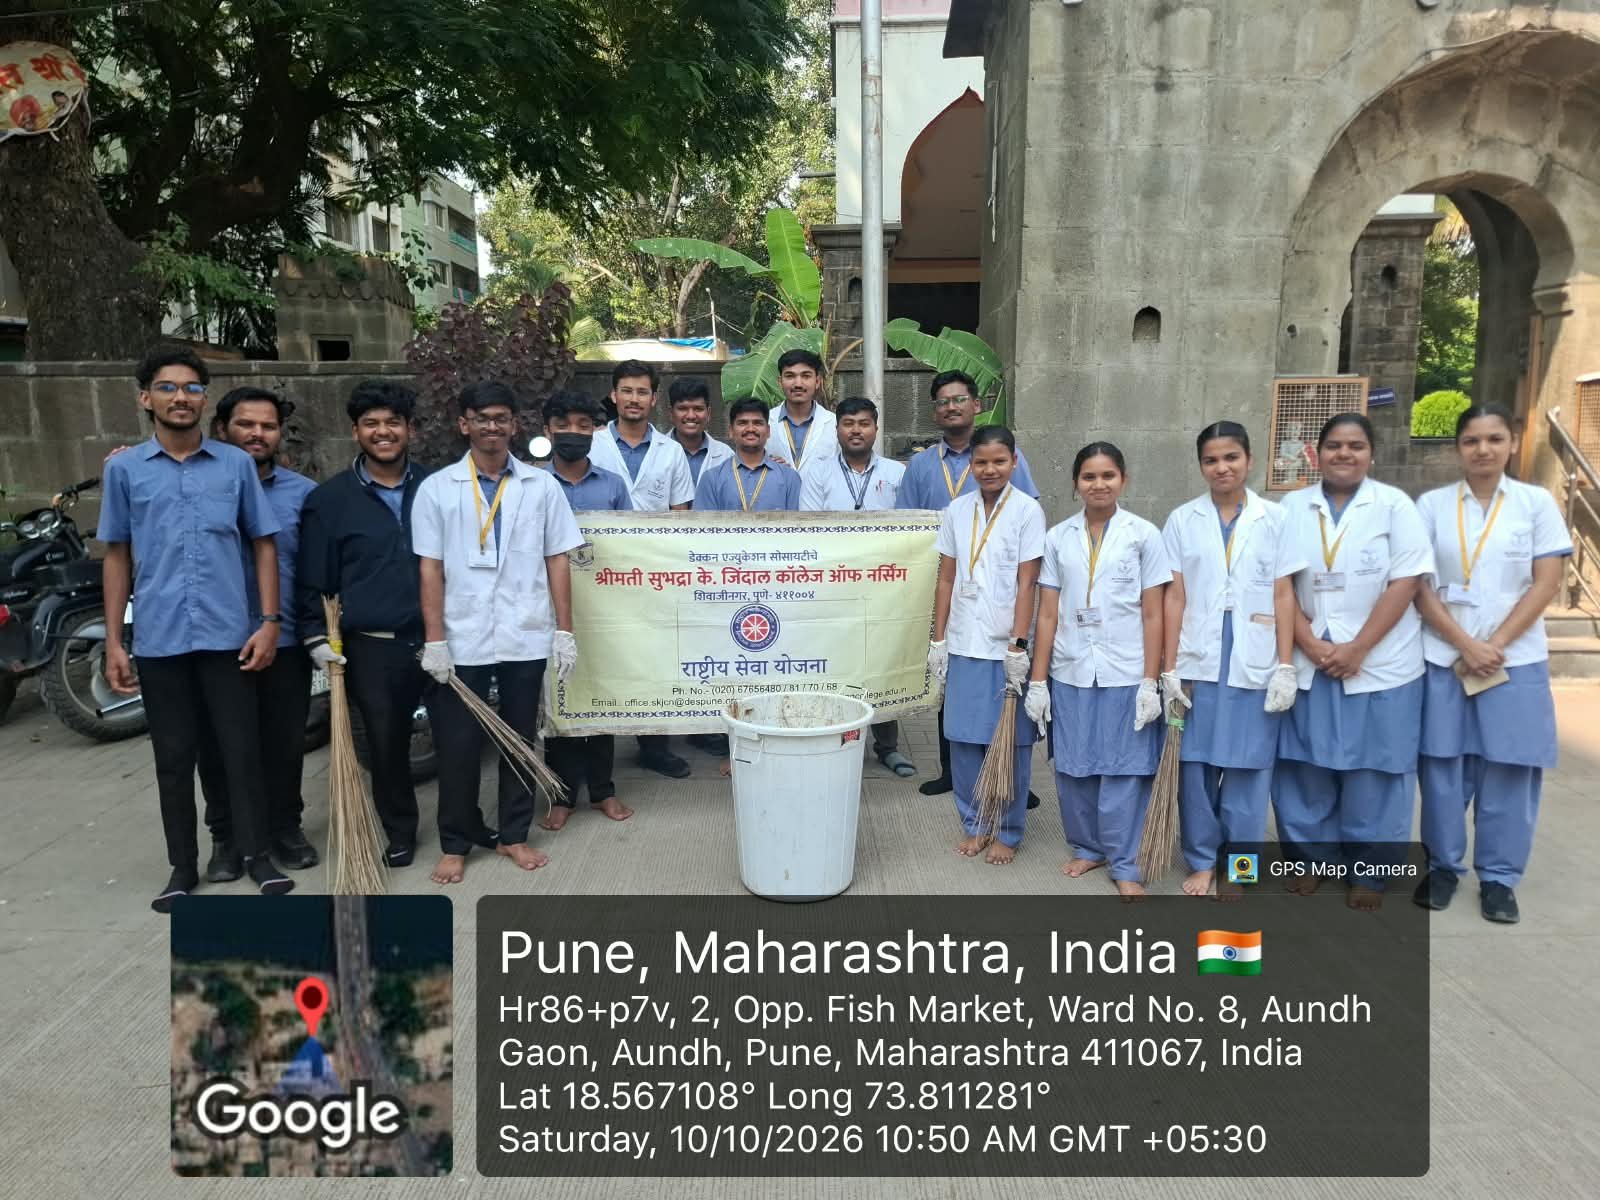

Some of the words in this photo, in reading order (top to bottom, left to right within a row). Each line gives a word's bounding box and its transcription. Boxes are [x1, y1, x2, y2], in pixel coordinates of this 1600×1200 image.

[688, 550, 718, 562] डेक्कन
[721, 550, 766, 565] एज्युकेशन
[769, 549, 818, 561] सोसायटीचे
[595, 567, 643, 586] श्रीमती
[648, 570, 692, 591] सुभद्रा
[696, 566, 717, 585] के.
[721, 566, 771, 586] जिंदाल
[775, 564, 824, 583] कॉलेज
[829, 563, 863, 582] ऑफ
[866, 563, 908, 582] नर्सिंग
[681, 656, 729, 684] राष्ट्रीय
[735, 654, 768, 676] सेवा
[773, 653, 828, 675] योजना
[672, 687, 687, 695] Ph.
[809, 683, 819, 691] 70
[826, 682, 838, 691] 68
